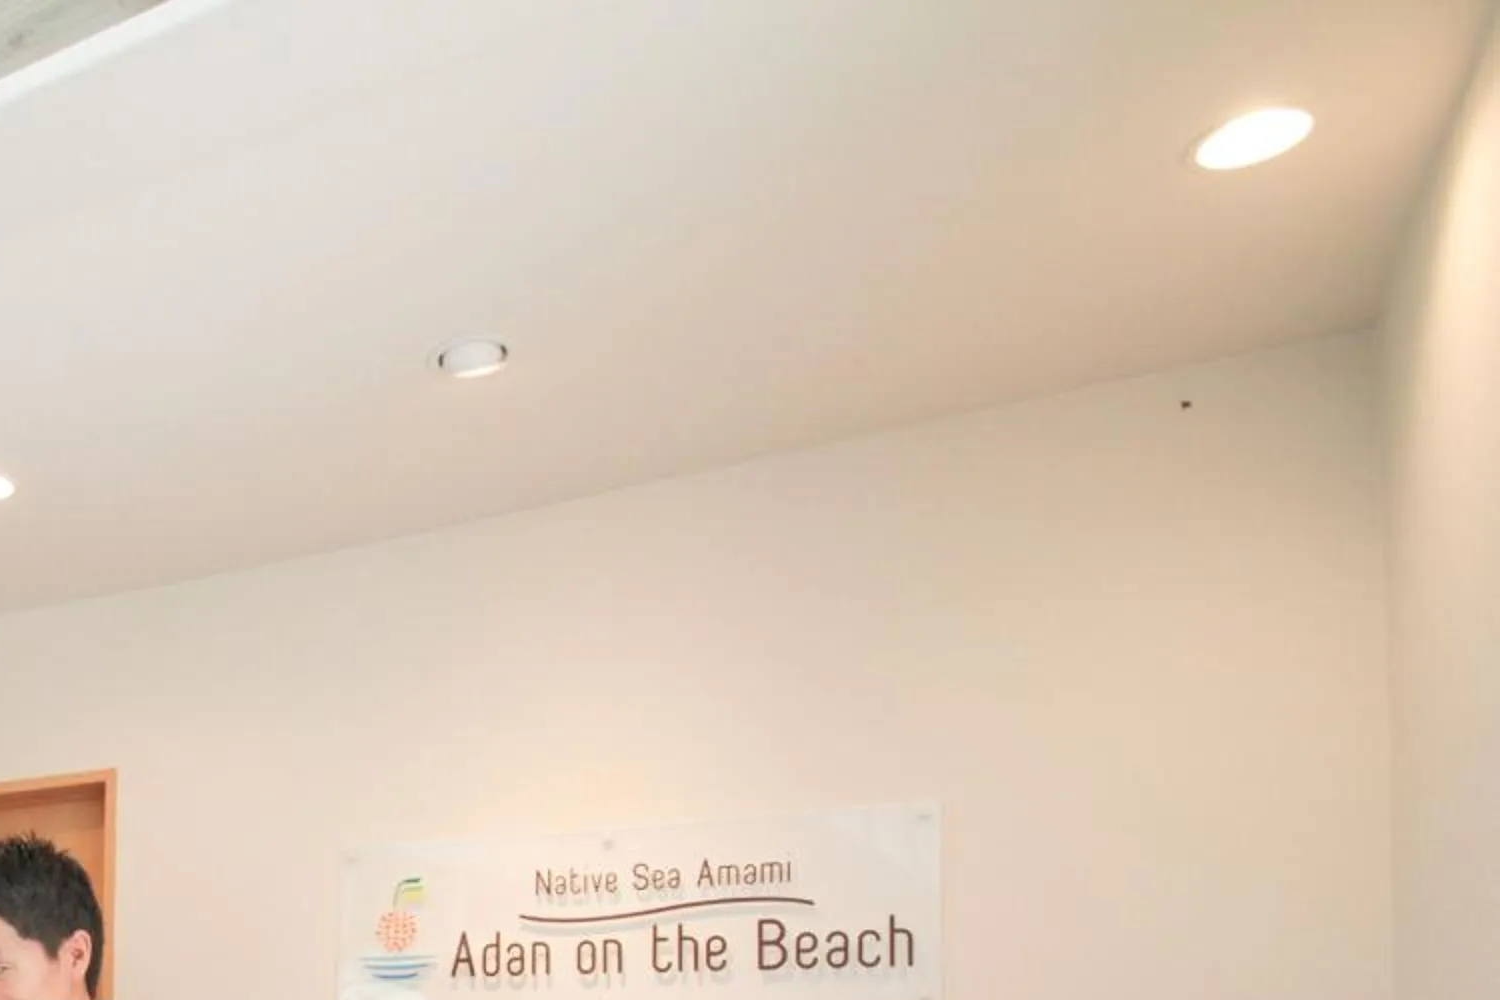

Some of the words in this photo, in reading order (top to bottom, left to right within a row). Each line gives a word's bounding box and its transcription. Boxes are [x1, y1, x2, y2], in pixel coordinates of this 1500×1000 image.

[535, 869, 618, 896] Native
[633, 863, 681, 891] Sea
[698, 858, 792, 888] Amami
[451, 931, 551, 978] Adan
[577, 938, 623, 975] on
[652, 924, 728, 973] the
[757, 914, 915, 970] Beach
